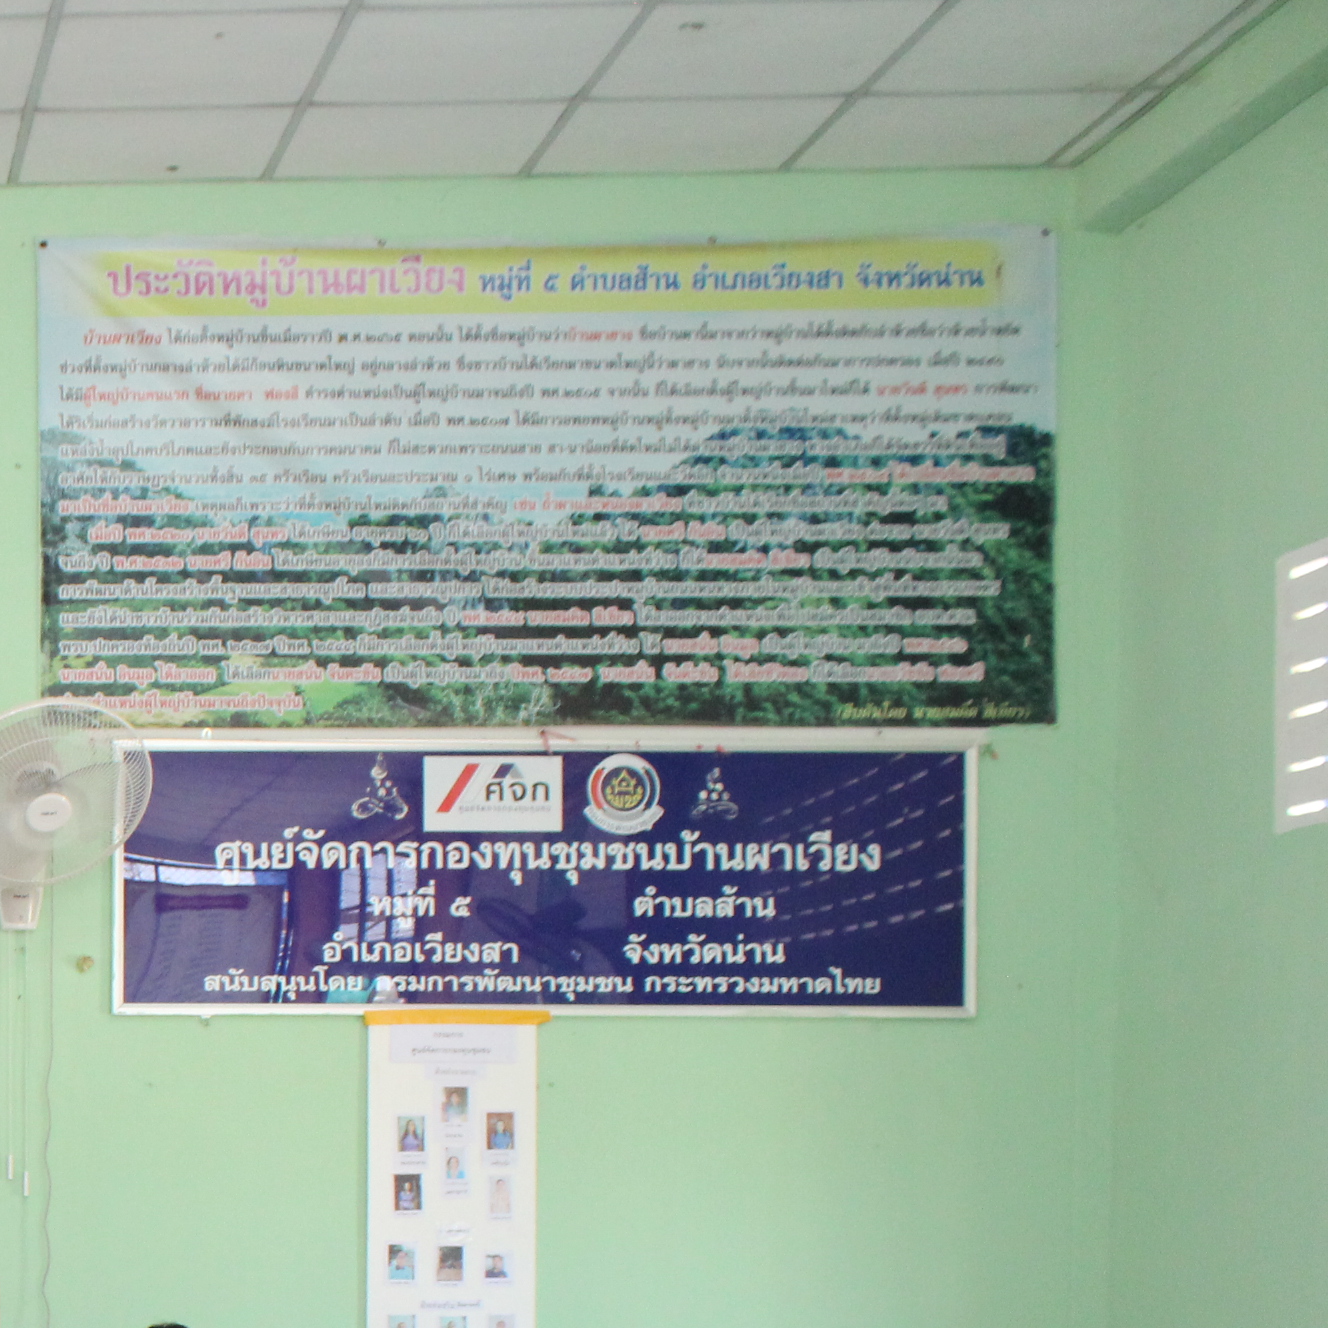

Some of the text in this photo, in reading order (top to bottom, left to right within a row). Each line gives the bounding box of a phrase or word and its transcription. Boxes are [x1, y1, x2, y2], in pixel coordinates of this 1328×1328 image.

[106, 253, 467, 309] ประวัติหมู่บ้านผาเวียง
[693, 262, 845, 291] อำเภอเวียงสา
[856, 262, 985, 289] จังหวัดน่าน
[484, 779, 551, 801] ศจก
[214, 826, 883, 886] ศูนย์จัดการกองทุนชุมชนบ้านผาเวียง
[369, 880, 472, 929] หมู่ที่ ๕
[633, 885, 776, 918] ตำบลส้าน
[322, 931, 520, 963] อำเภอเวียงสา
[623, 934, 786, 964] จังหวัดน่าน
[204, 965, 882, 1001] สนับสนุนโดย กรมการพัฒนาชุมชน กระทรวงมหาดไทย
